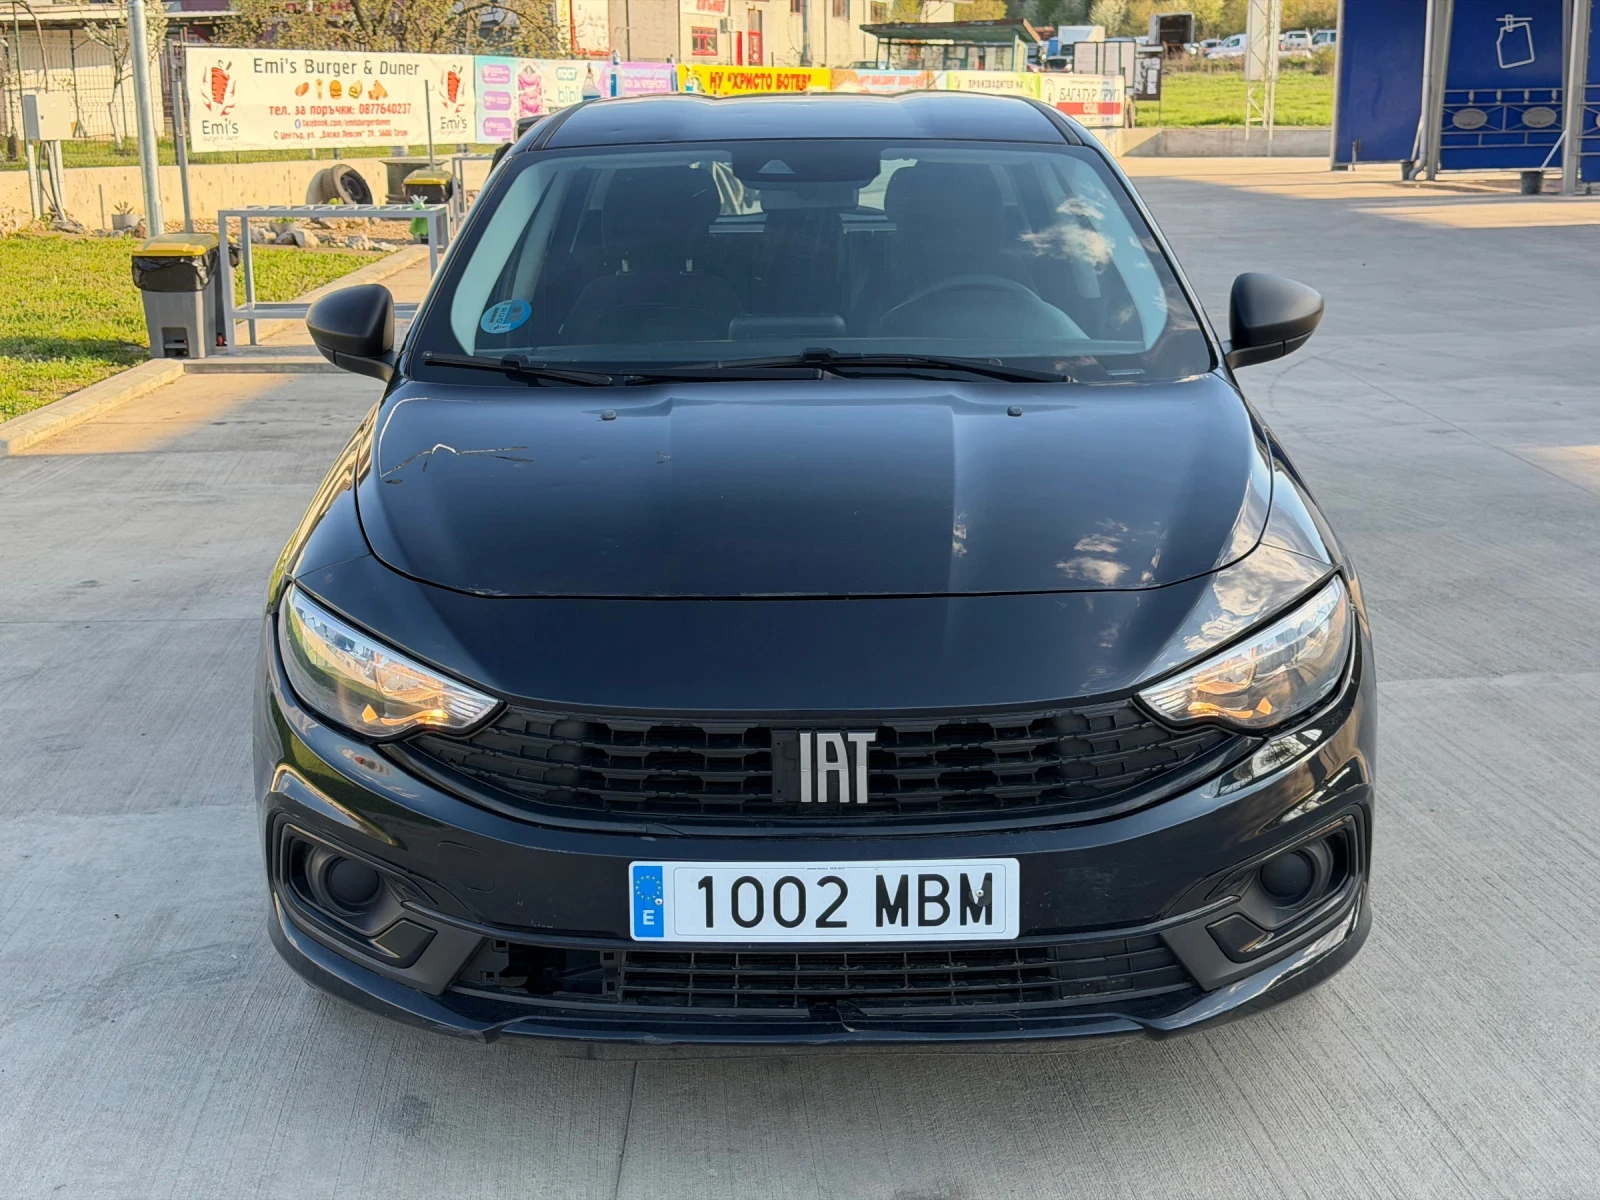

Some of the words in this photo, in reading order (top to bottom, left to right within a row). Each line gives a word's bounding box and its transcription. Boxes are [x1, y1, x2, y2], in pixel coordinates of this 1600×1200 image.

[253, 58, 297, 74] Emi's
[304, 58, 357, 77] Burger
[363, 60, 373, 75] &
[379, 60, 420, 75] Duner
[269, 105, 291, 116] тел.
[294, 105, 306, 115] за
[310, 105, 355, 118] поръчки:
[358, 103, 412, 115] 0877640237
[202, 117, 239, 135] Emi's
[440, 114, 468, 130] Emi's
[697, 874, 849, 929] 1002
[874, 872, 994, 928] MBM
[642, 909, 656, 926] E
